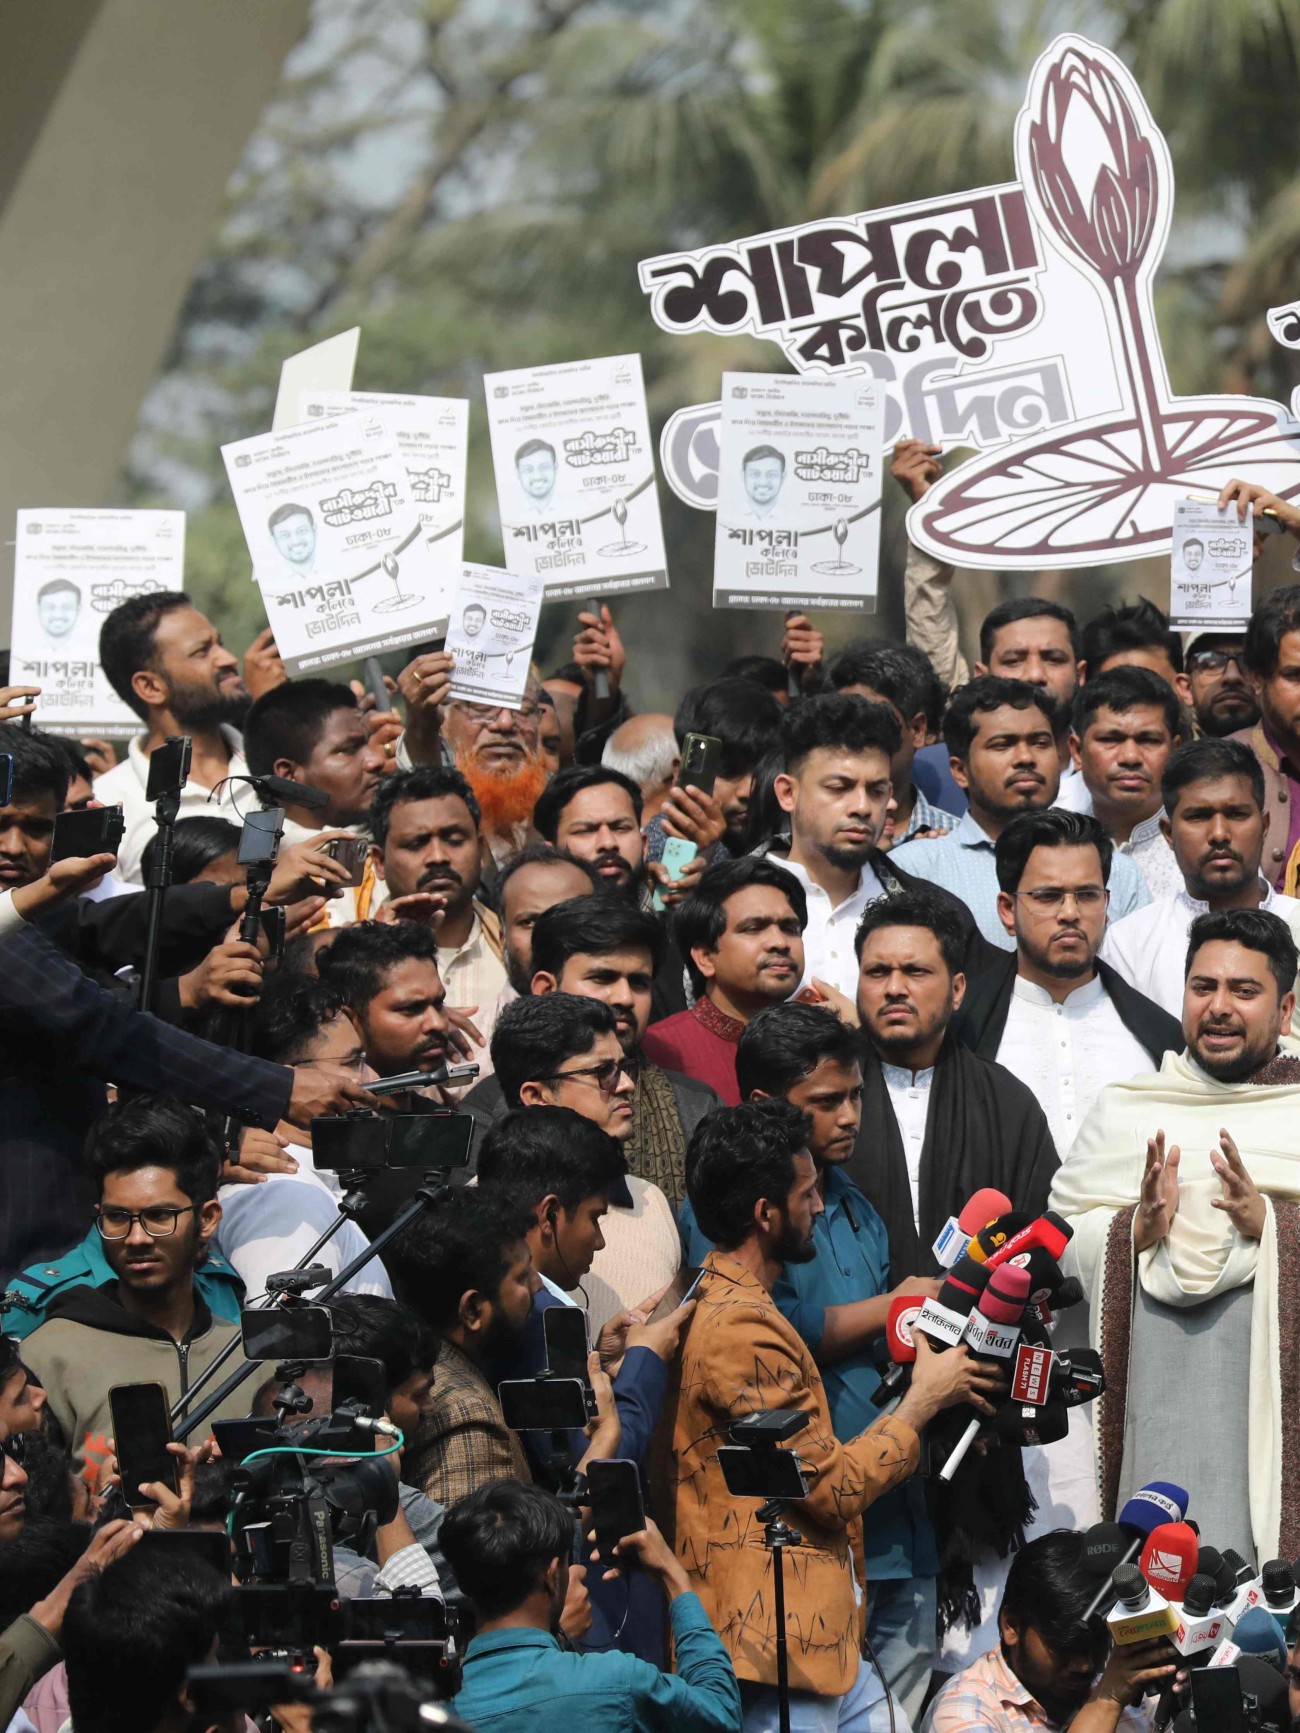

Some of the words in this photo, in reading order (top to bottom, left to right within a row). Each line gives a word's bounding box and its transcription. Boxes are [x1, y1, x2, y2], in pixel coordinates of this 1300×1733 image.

[651, 190, 1039, 326] শাপলা
[789, 277, 1038, 366] কলিতে
[511, 518, 582, 544] শাপলা
[544, 532, 584, 552] কলিতে
[727, 528, 799, 547] শাপলা
[759, 544, 799, 560] কলিতে
[275, 577, 353, 613] শাপলা
[312, 592, 357, 617] কলিতে
[921, 1308, 962, 1336] ইনকিলাব
[985, 1332, 1015, 1350] খবর
[1028, 1353, 1043, 1398] NEWS
[314, 1510, 331, 1580] Panasonic
[1087, 1544, 1120, 1556] RØDE
